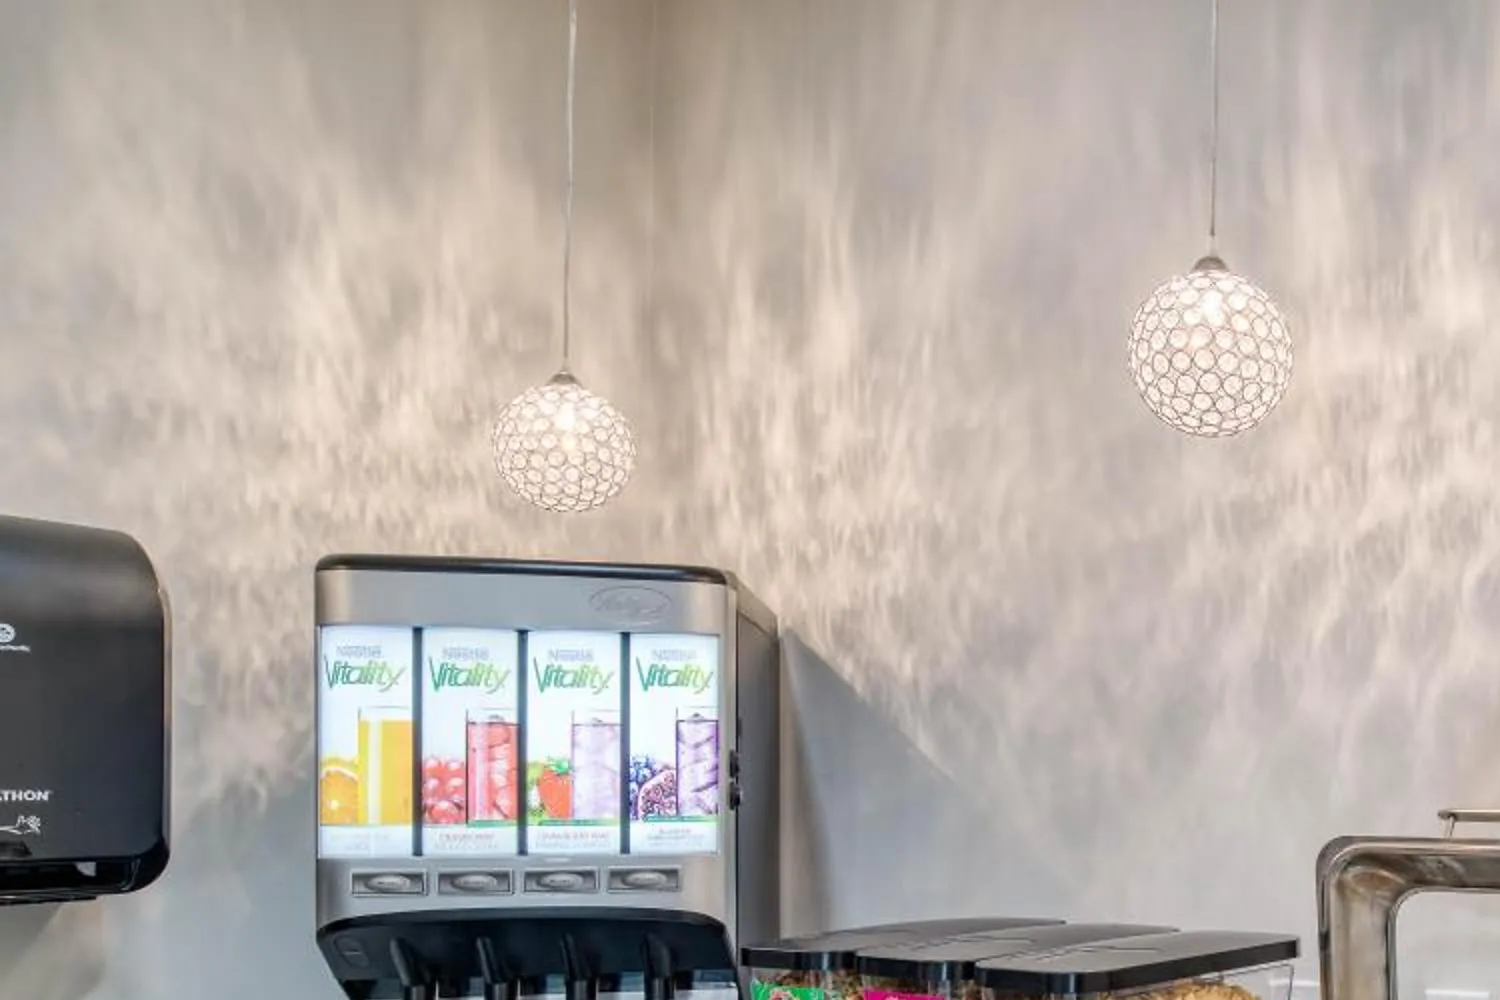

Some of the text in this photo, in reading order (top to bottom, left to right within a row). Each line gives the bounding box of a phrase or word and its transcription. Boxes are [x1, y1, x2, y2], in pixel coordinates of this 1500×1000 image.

[324, 655, 406, 693] Vitality
[428, 656, 511, 694] Vitality
[533, 656, 615, 695] Vitality
[635, 656, 714, 695] Vitality
[0, 789, 49, 801] THON
